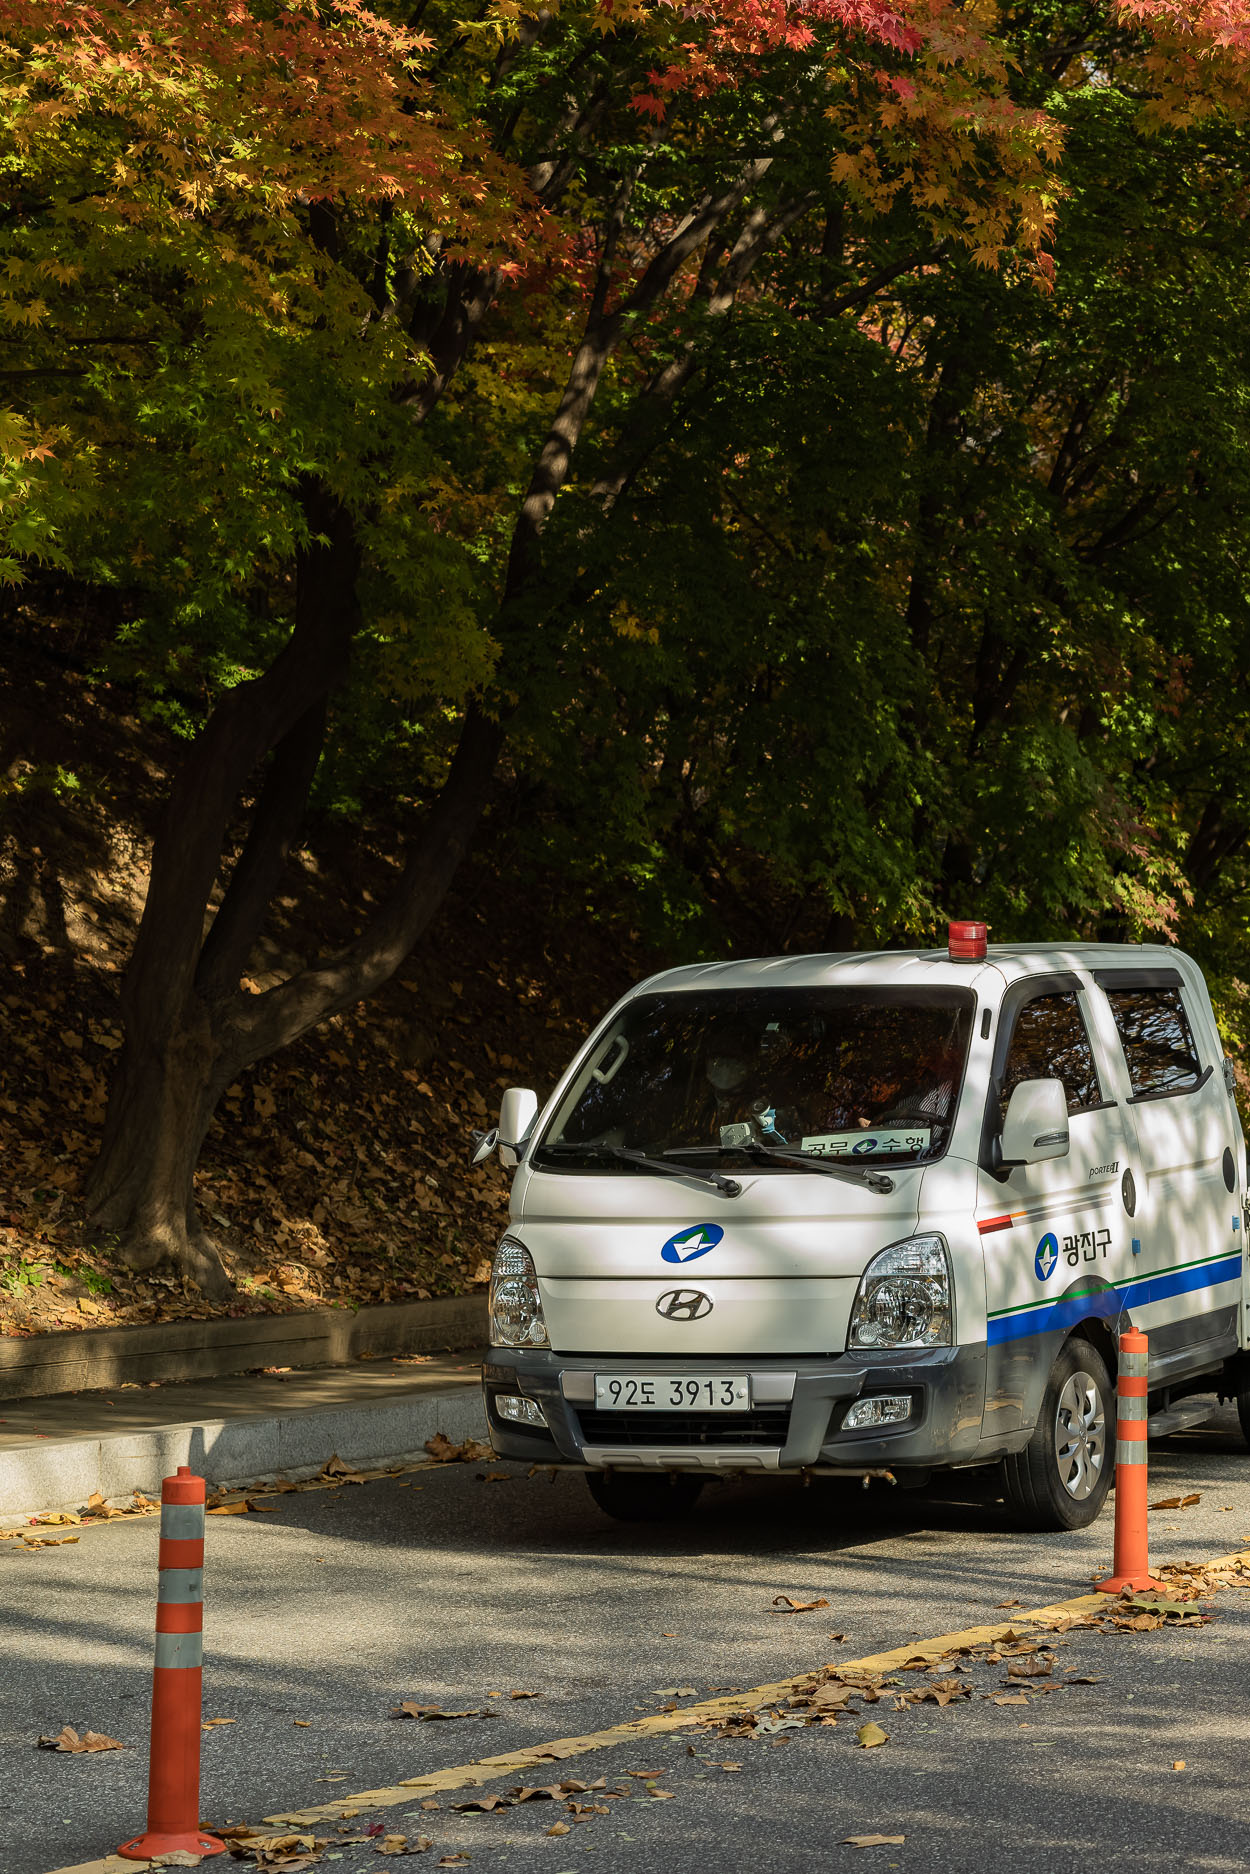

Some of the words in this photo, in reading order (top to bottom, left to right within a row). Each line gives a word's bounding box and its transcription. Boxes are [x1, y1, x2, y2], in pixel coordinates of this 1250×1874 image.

[807, 1141, 848, 1157] 공무
[881, 1136, 924, 1152] 수행
[1062, 1228, 1112, 1267] 광진구
[609, 1380, 656, 1405] 92도
[669, 1380, 735, 1406] 3913
